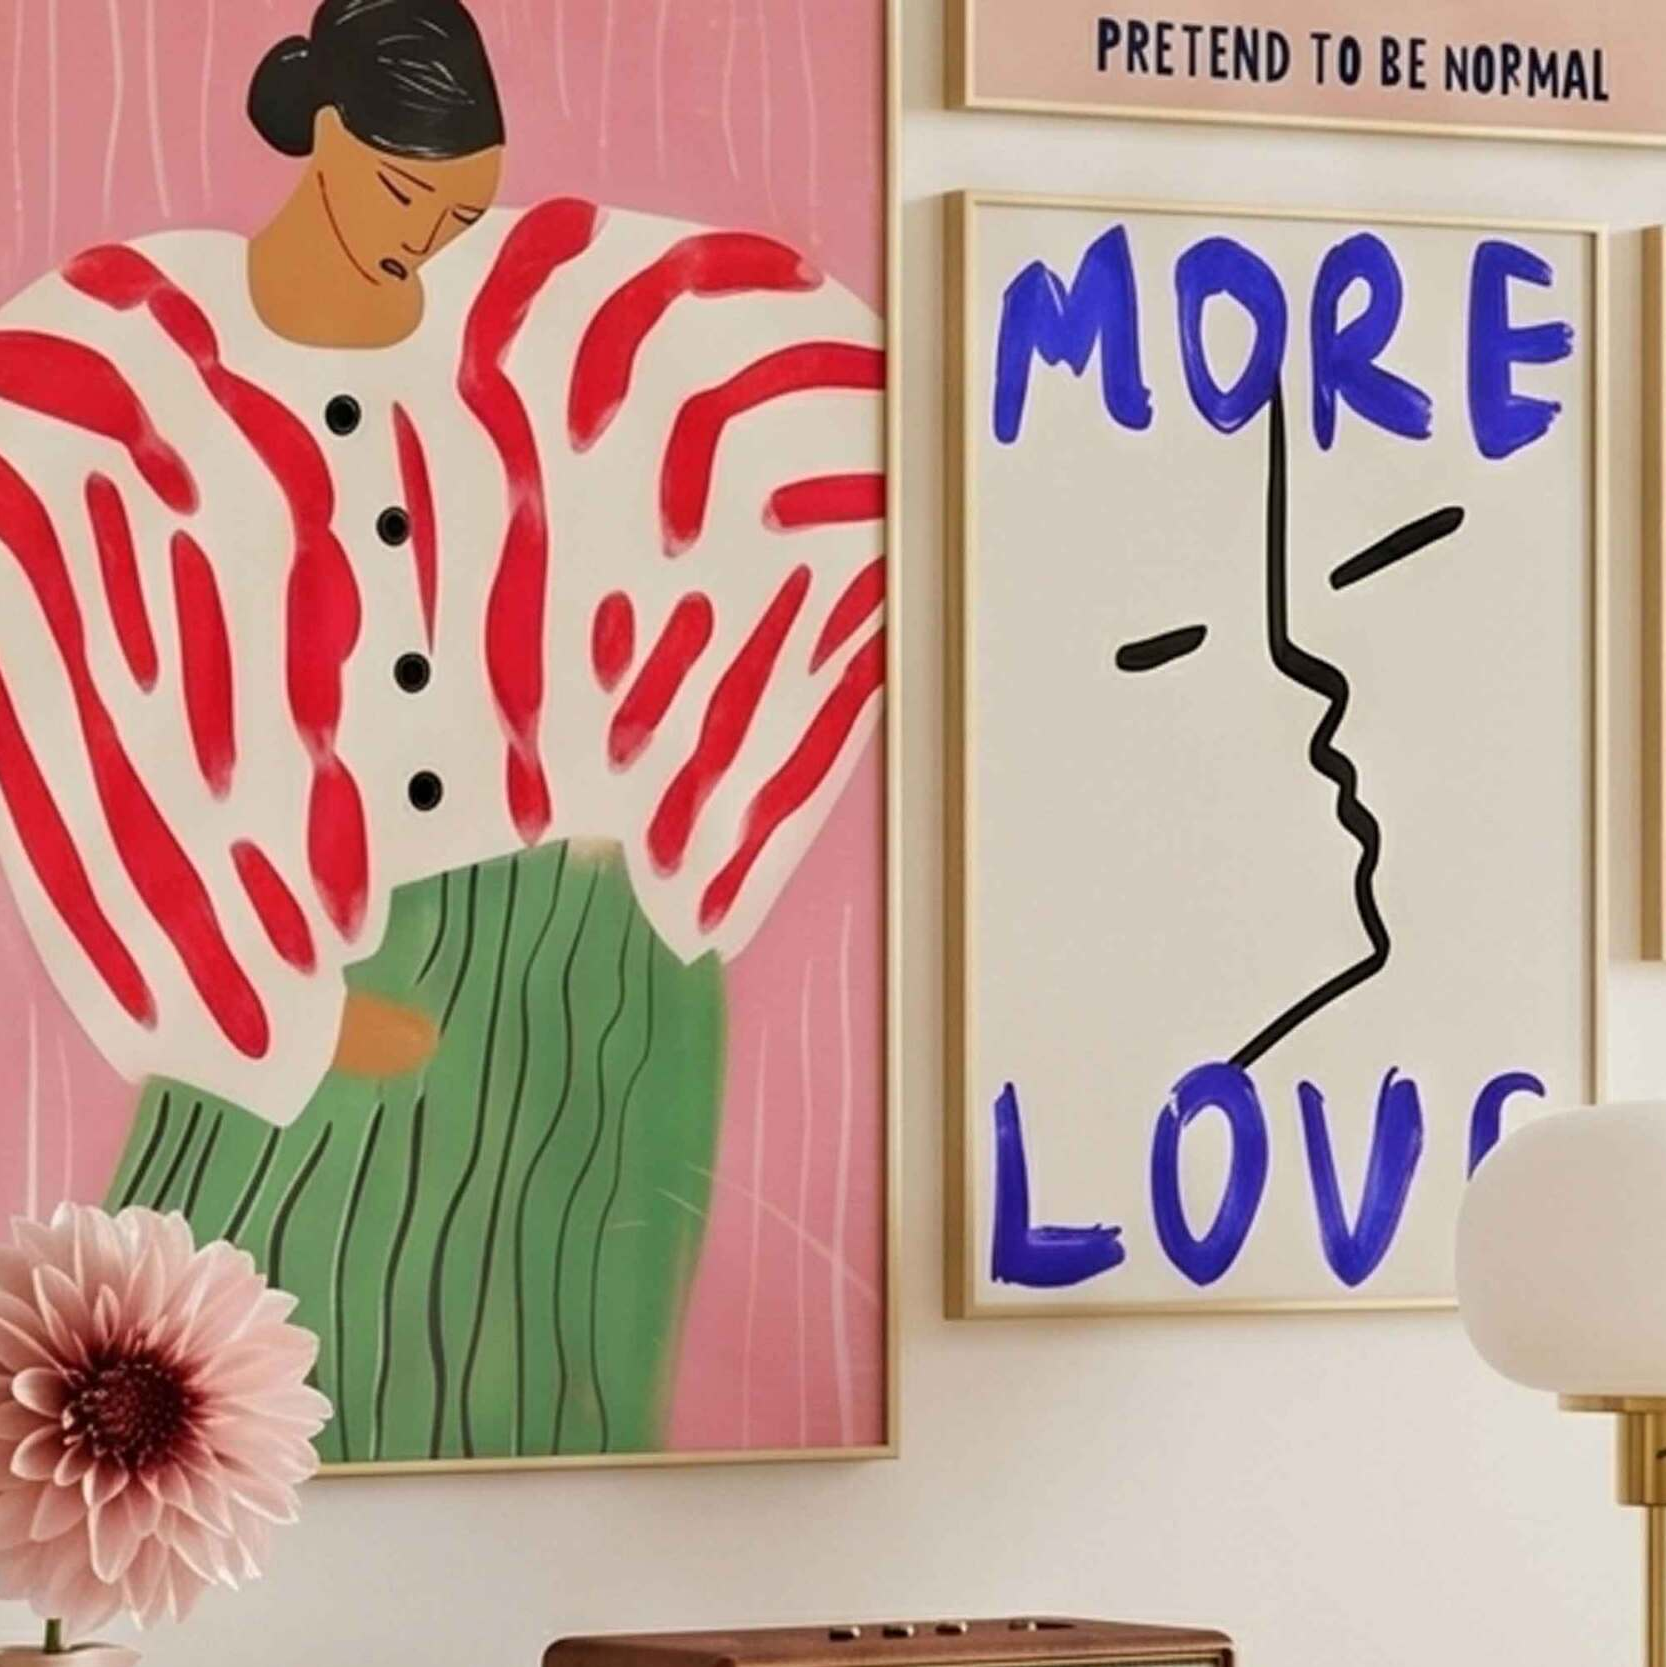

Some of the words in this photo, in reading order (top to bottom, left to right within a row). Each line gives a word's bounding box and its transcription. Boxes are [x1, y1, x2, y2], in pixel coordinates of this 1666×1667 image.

[1097, 17, 1291, 83] PRETEND
[1310, 32, 1362, 86] TO
[1381, 36, 1427, 90] BE
[1445, 42, 1609, 101] NORMAL
[991, 224, 1573, 460] MORE
